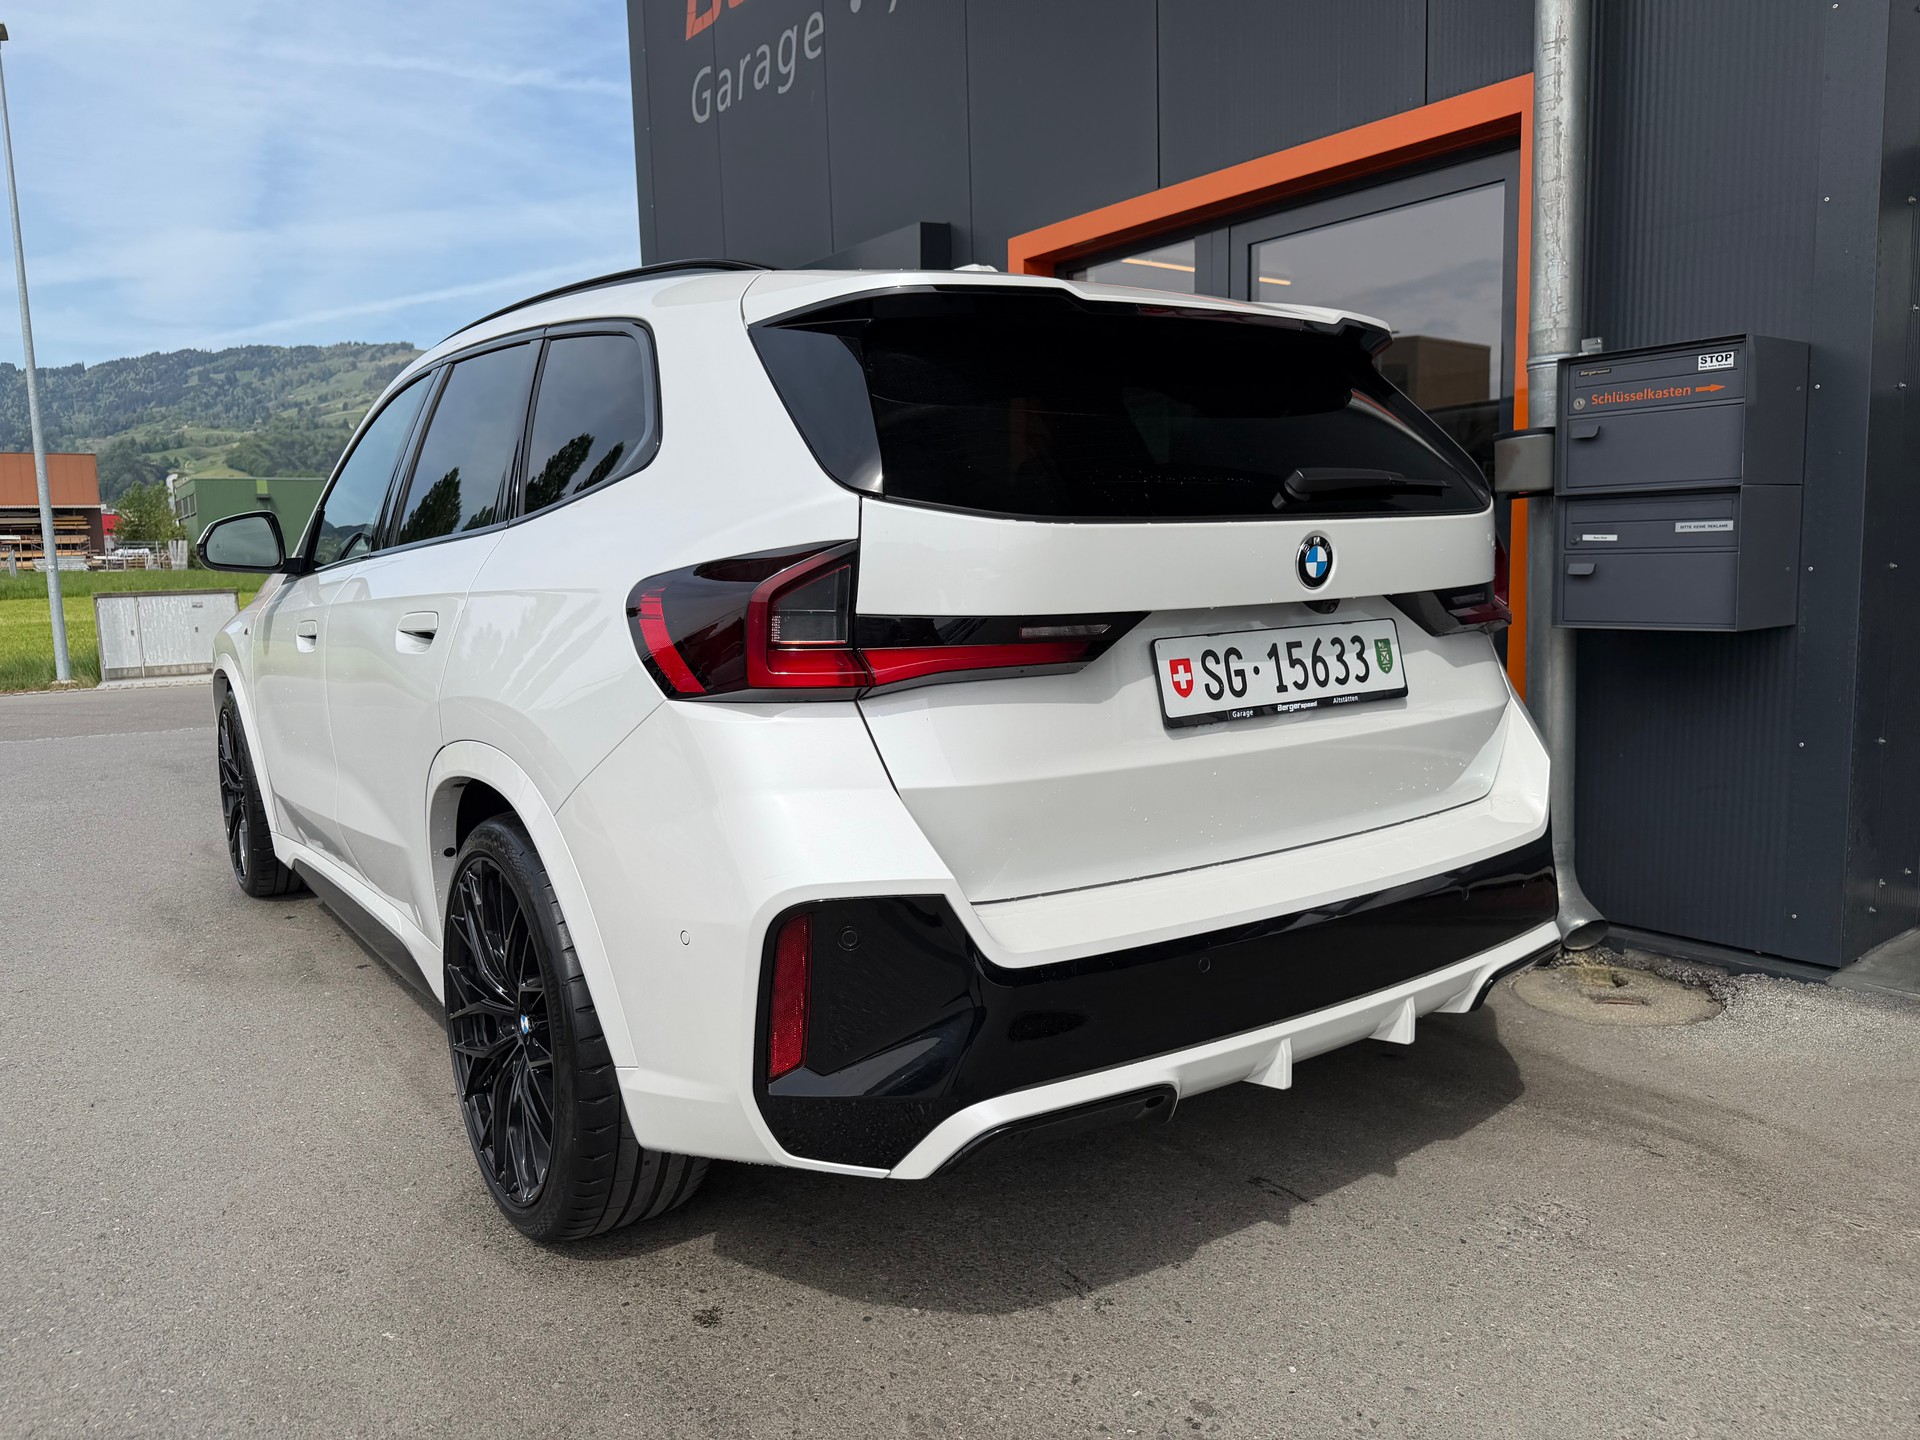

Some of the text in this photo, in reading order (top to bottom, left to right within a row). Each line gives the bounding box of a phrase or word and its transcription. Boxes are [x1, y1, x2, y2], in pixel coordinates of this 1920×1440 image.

[691, 11, 825, 123] Garage
[1700, 353, 1732, 365] STOP
[1592, 387, 1691, 405] Schlüsselkasten
[1301, 536, 1332, 554] BMW
[1232, 709, 1254, 718] Garage
[1333, 695, 1359, 704] Altstätten
